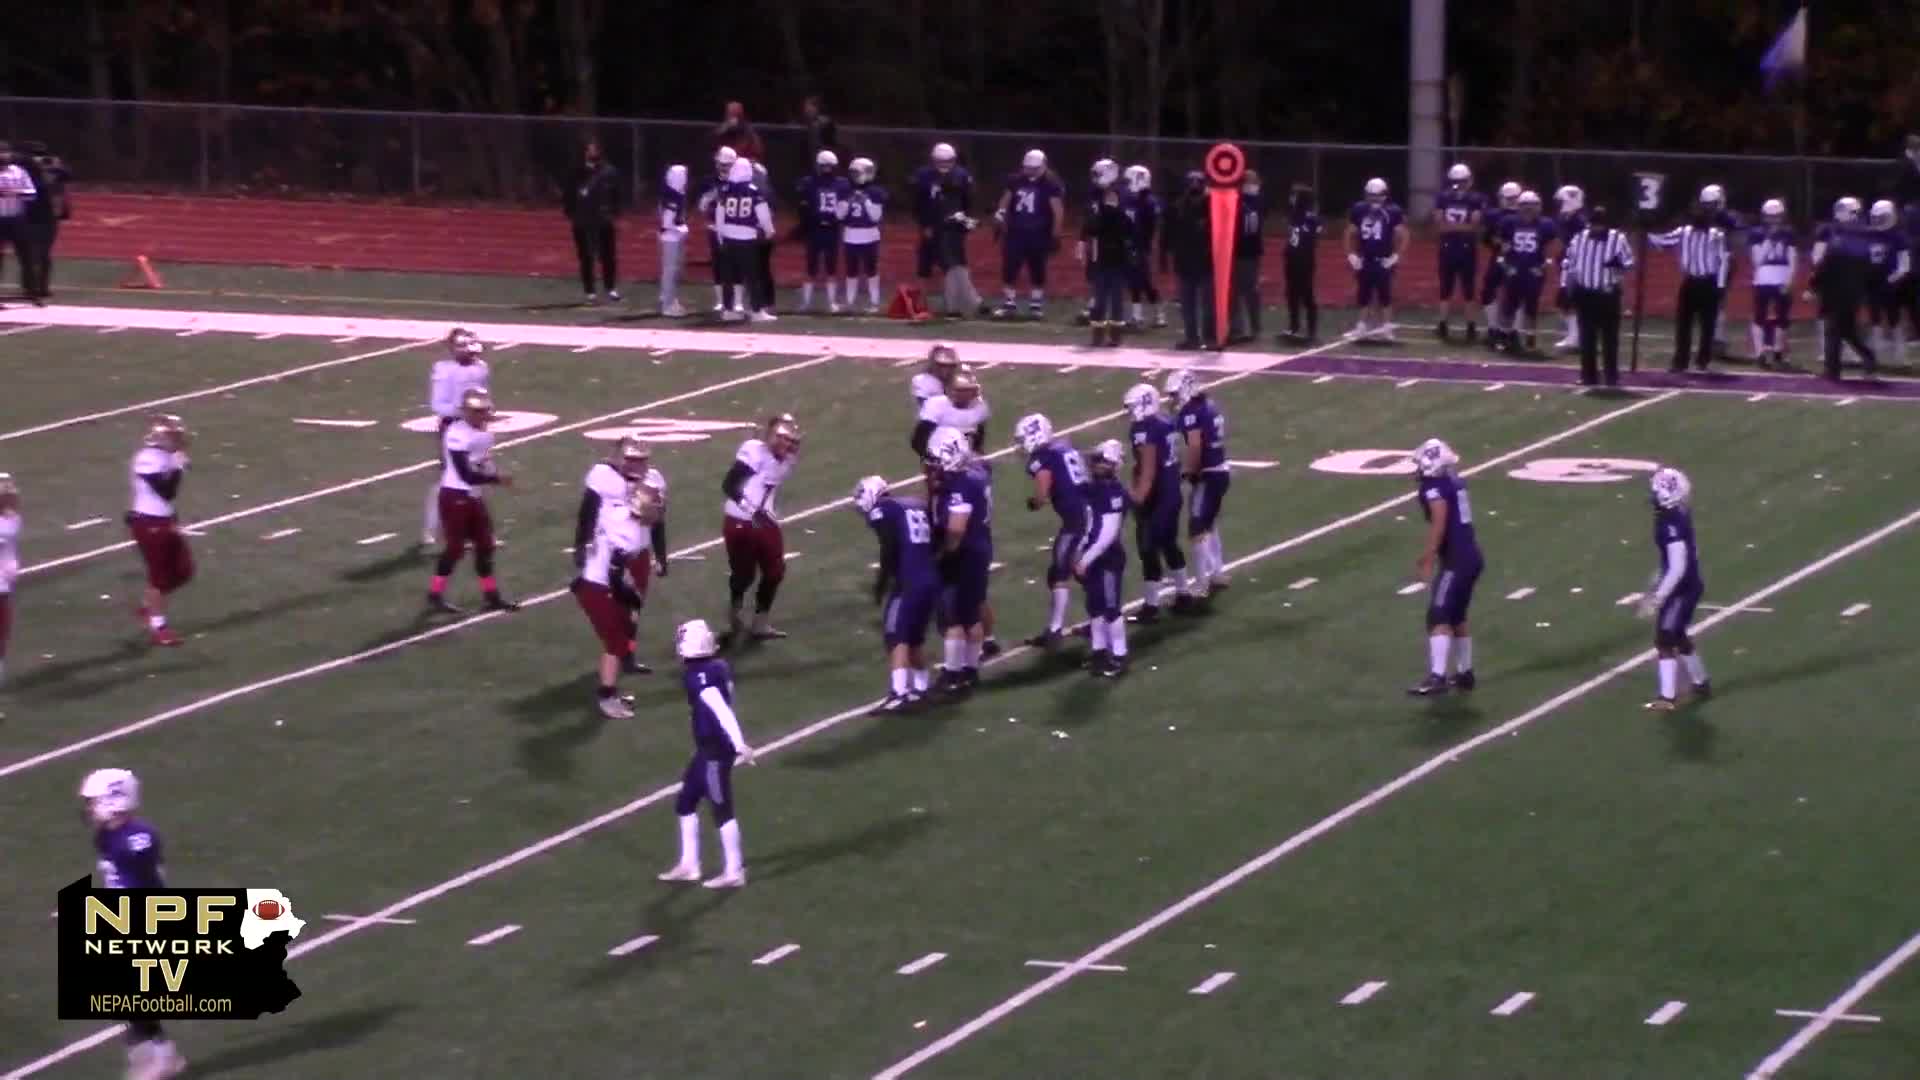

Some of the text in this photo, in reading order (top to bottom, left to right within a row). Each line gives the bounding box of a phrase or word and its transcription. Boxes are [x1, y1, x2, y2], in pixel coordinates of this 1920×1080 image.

[1638, 176, 1658, 209] 3
[726, 196, 752, 218] 88
[1513, 231, 1536, 252] 55
